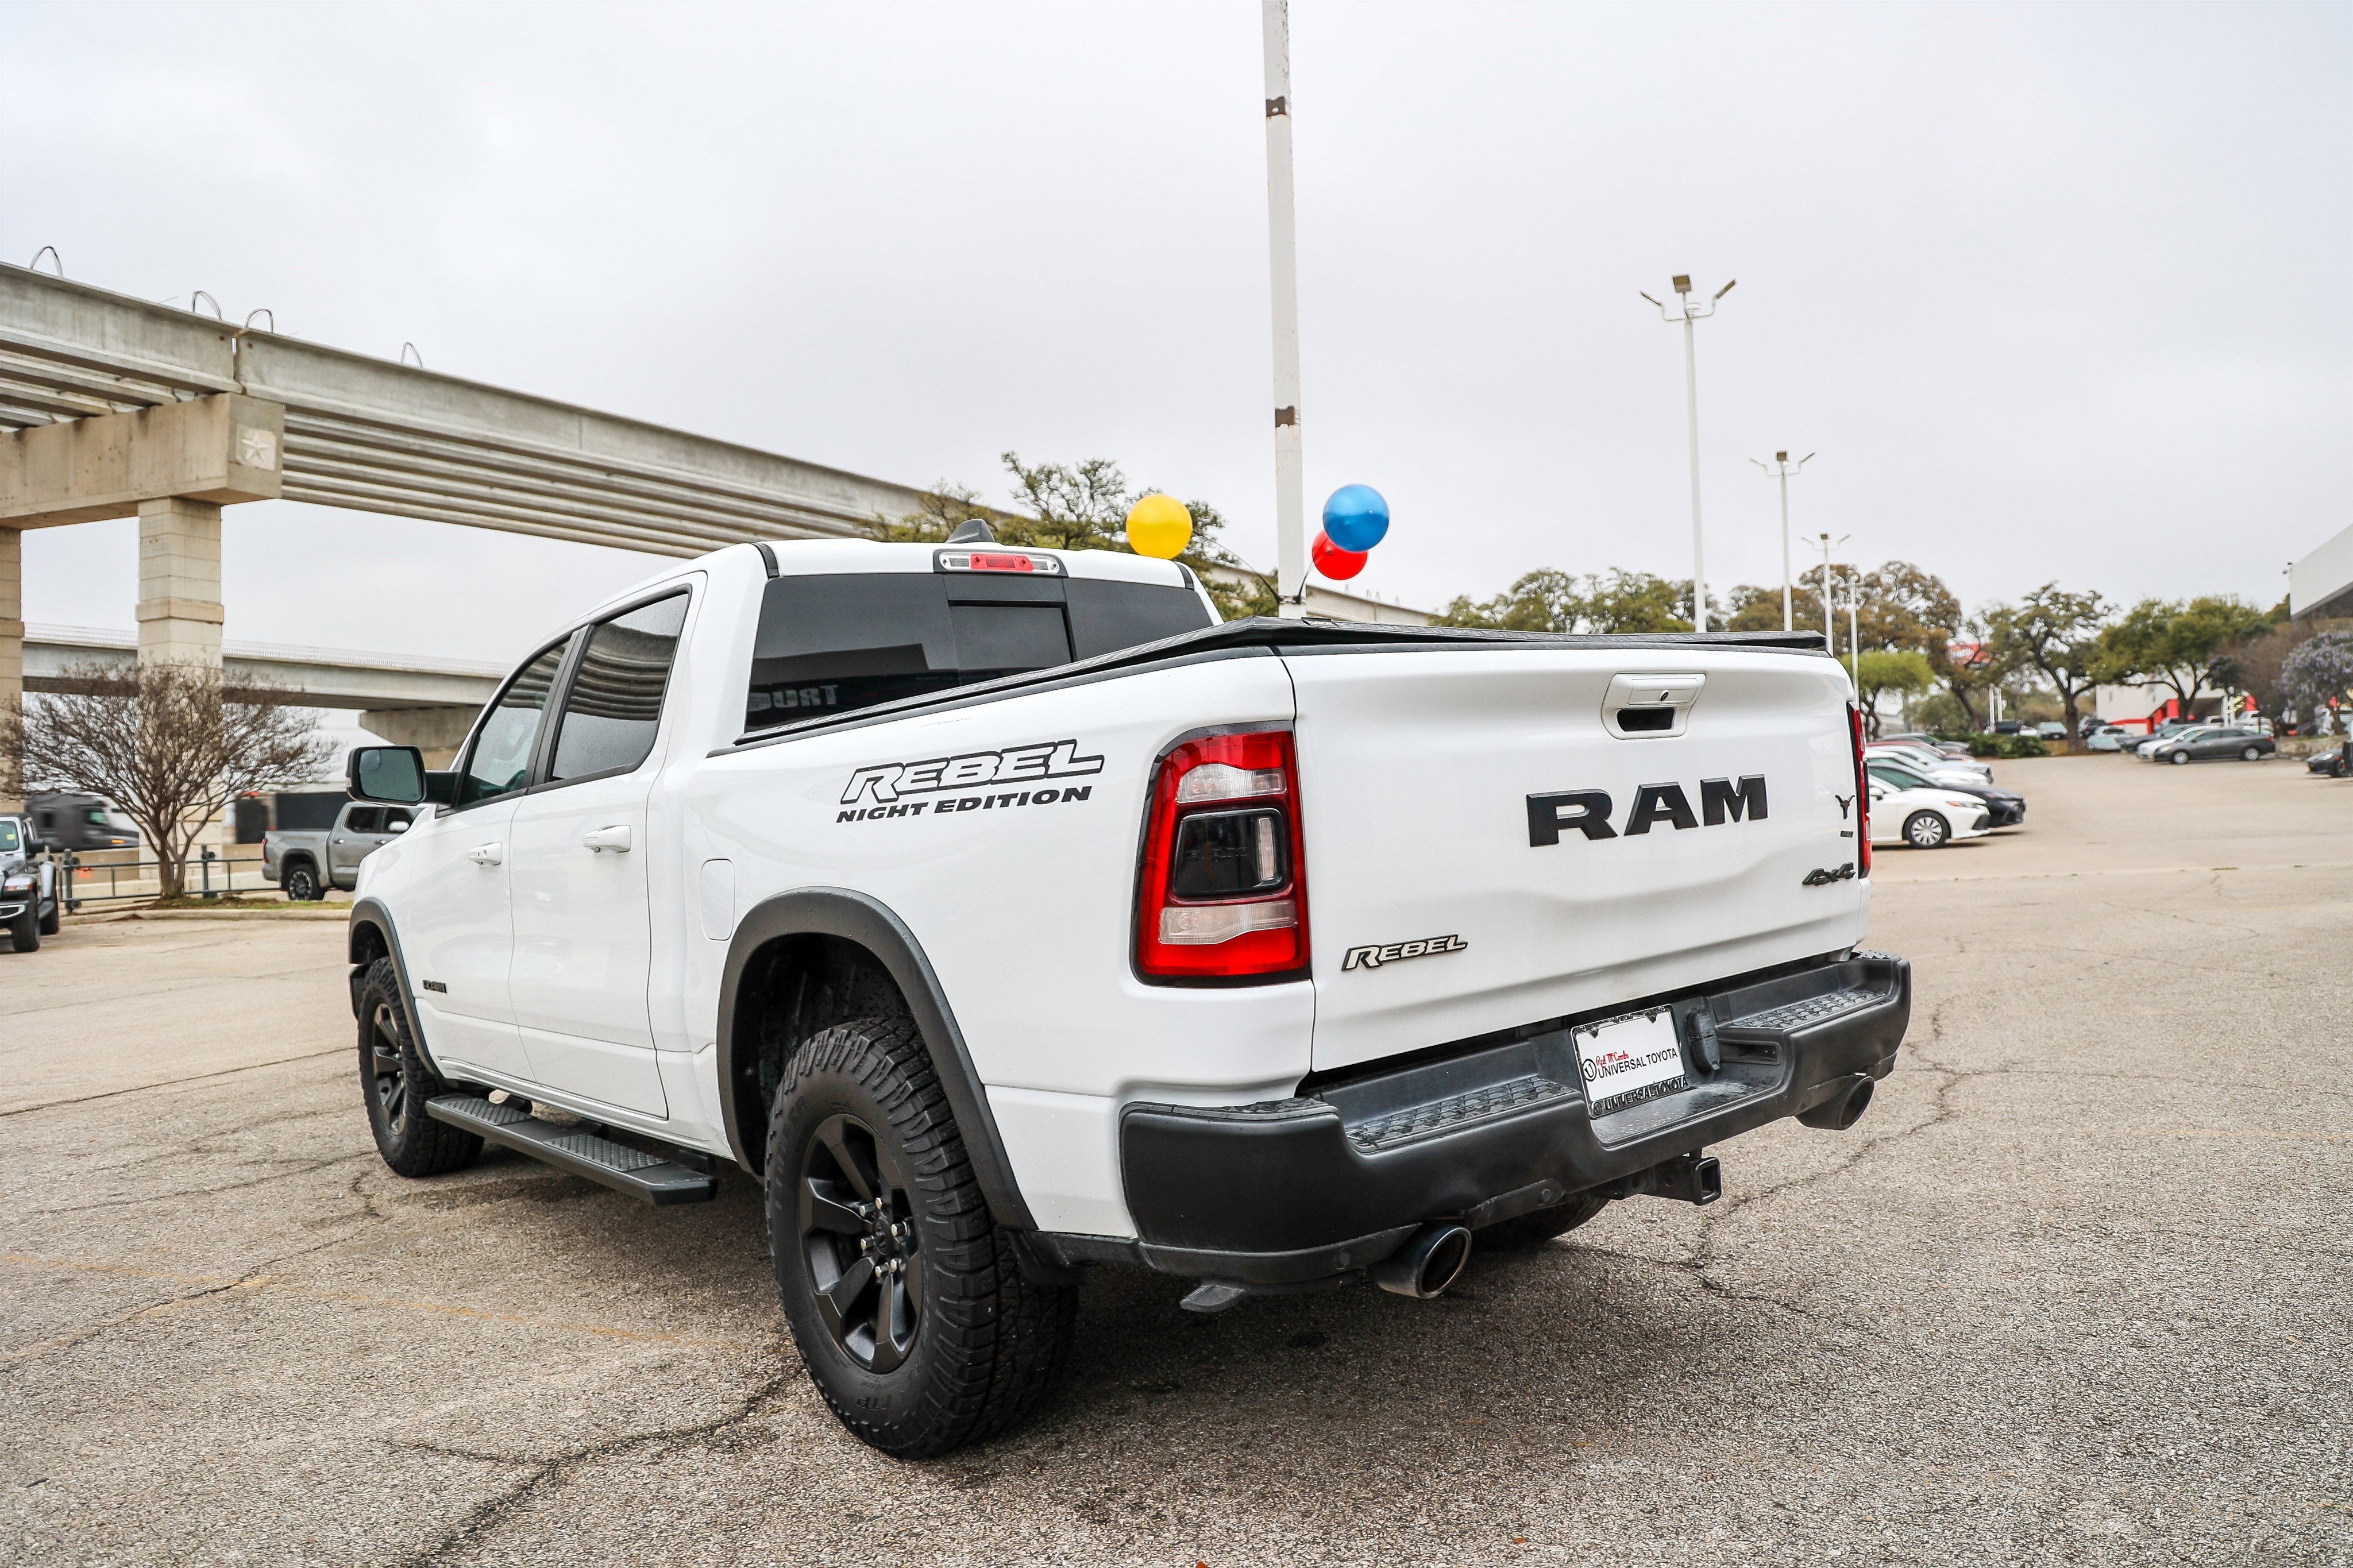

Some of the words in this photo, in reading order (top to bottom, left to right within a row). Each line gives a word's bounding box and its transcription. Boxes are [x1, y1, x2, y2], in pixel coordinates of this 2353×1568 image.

[840, 739, 1105, 805] REBEL
[836, 802, 929, 823] NIGHT
[934, 786, 1093, 814] EDITION
[1526, 774, 1768, 847] RAM
[1341, 933, 1468, 971] REBEL
[1598, 1056, 1648, 1078] UNIVERSAL
[1646, 1048, 1678, 1067] TOYOTA
[1604, 1087, 1655, 1111] UNIVERSAL
[1654, 1075, 1689, 1095] TOYOTA
